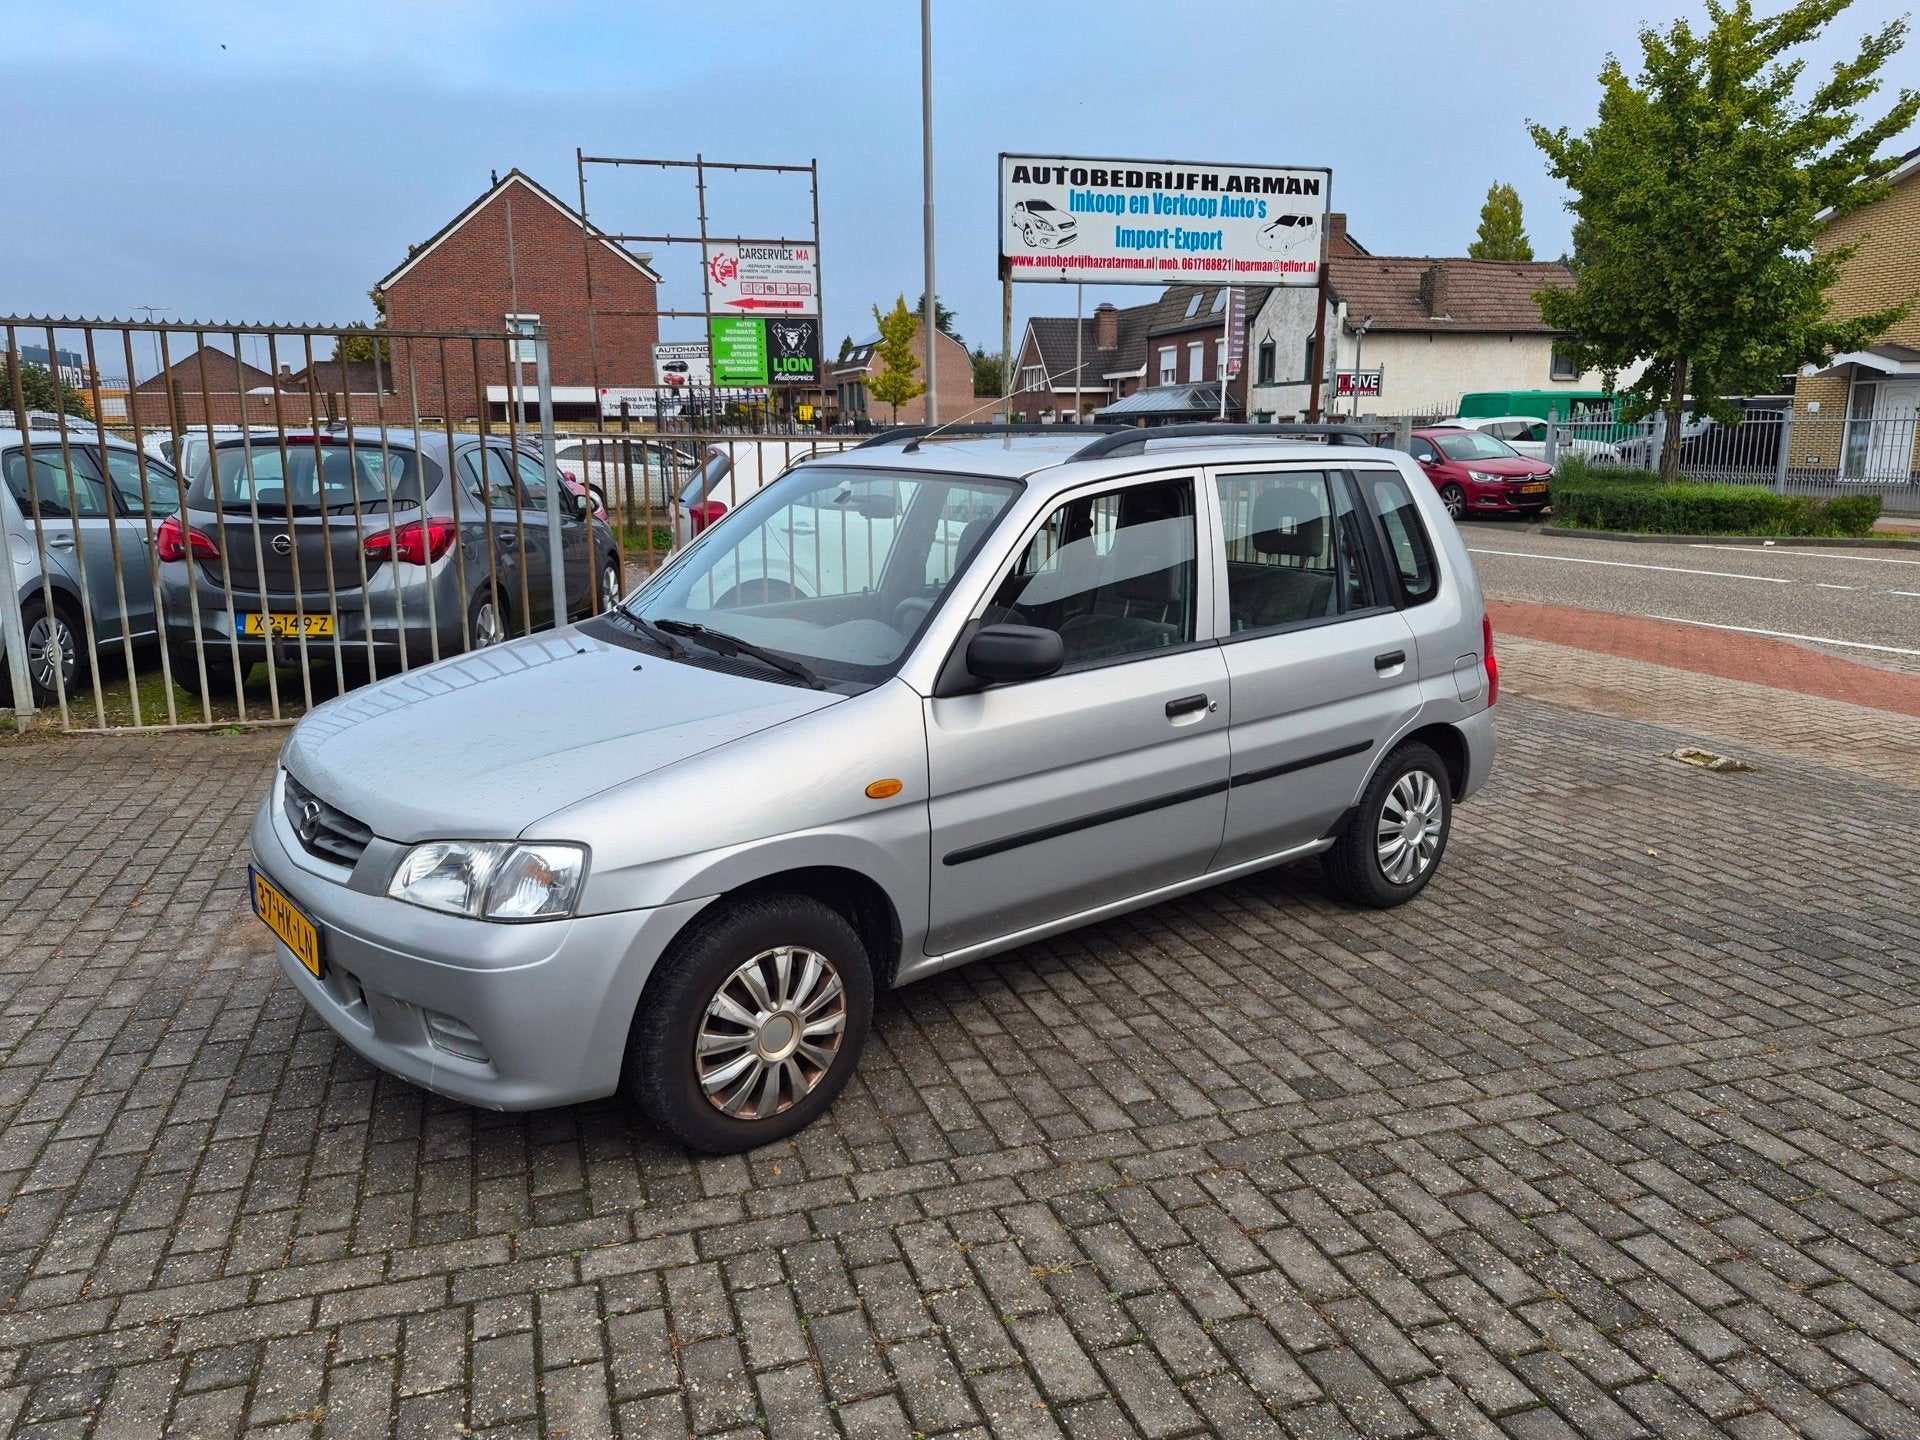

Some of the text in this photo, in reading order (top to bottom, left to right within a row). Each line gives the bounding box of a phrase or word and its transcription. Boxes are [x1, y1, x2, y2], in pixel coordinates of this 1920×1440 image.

[1070, 189, 1267, 219] Inkoop en Verkoop Auto's
[1115, 226, 1222, 252] Import-Export
[739, 248, 809, 261] CARSERVICE MA
[1159, 257, 1180, 270] mob.
[773, 358, 813, 372] LION
[774, 372, 815, 381] Autoservice
[258, 882, 313, 964] 37-HK-LN
